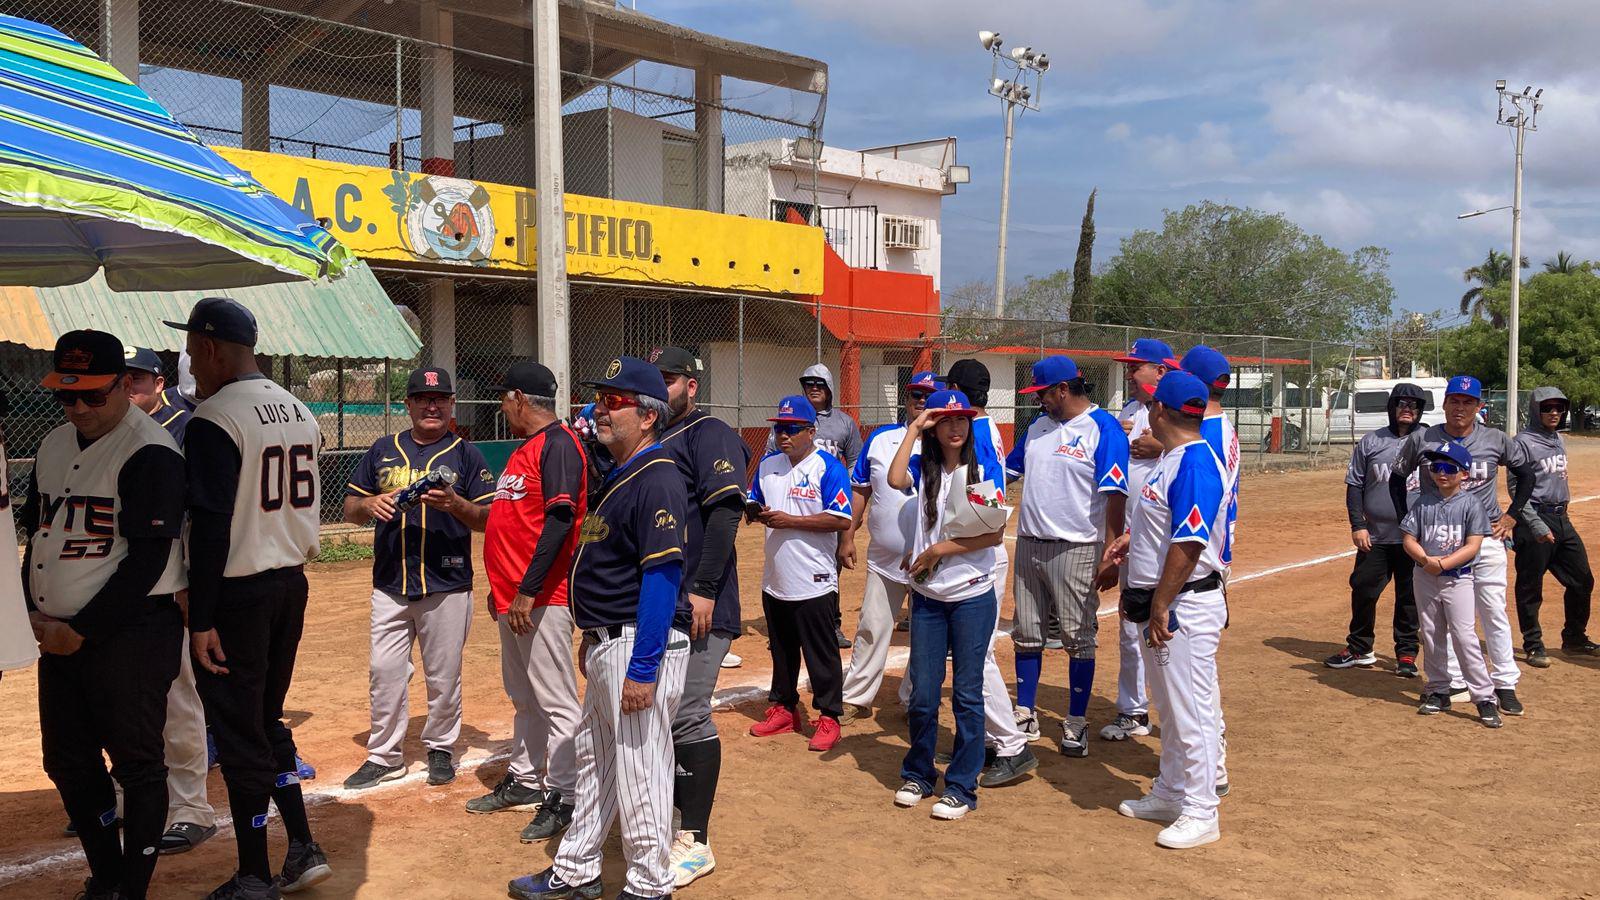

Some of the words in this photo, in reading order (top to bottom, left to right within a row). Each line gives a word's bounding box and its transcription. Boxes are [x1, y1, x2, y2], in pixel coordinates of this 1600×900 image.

[515, 191, 654, 265] PCIFICO
[254, 403, 290, 425] LUIS
[293, 403, 307, 423] A.
[1055, 445, 1086, 459] JAUS
[260, 444, 315, 513] 06
[788, 487, 816, 499] JAUS
[1424, 525, 1462, 541] WSH
[59, 538, 115, 560] 53
